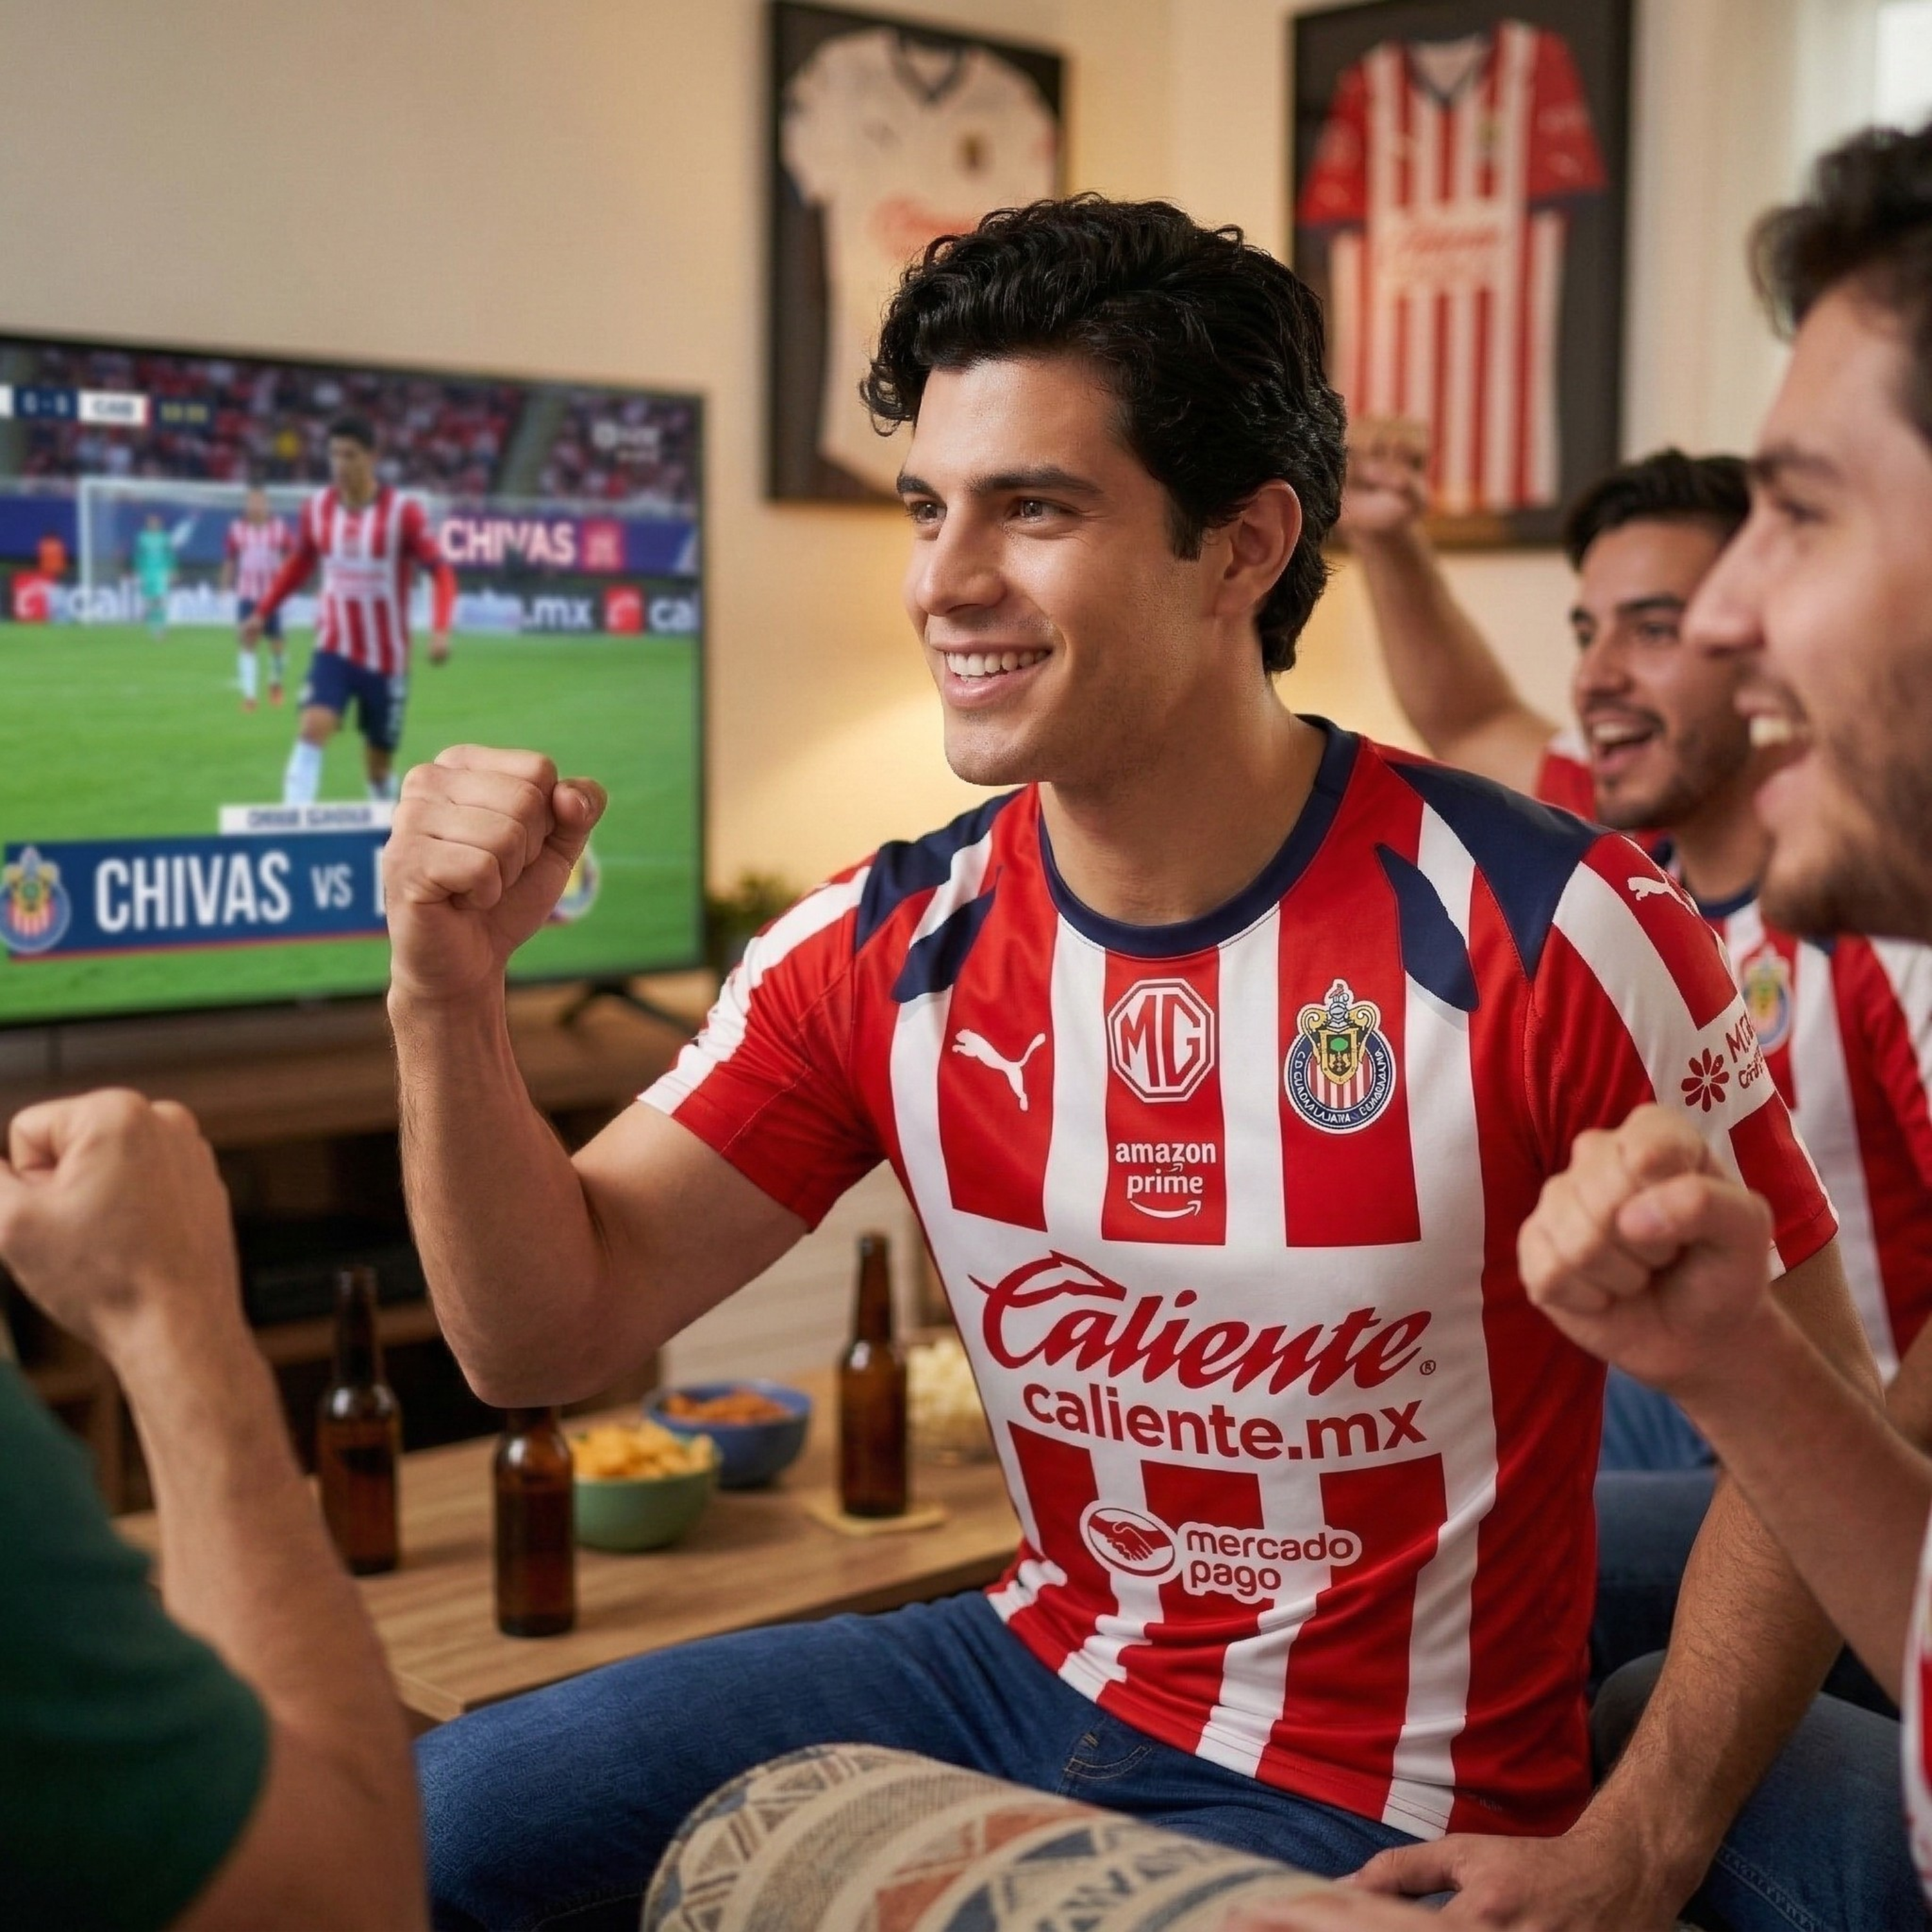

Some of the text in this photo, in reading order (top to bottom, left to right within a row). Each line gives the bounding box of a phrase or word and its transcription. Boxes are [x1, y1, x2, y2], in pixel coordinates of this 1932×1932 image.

[439, 518, 579, 567] CHIVAS
[95, 850, 291, 934] CHIVAS
[1121, 993, 1202, 1088] MG
[1115, 1140, 1216, 1164] amazon
[1126, 1168, 1203, 1199] prime
[967, 1249, 1432, 1397] Caliente
[1023, 1383, 1428, 1461] caliente.mx
[1186, 1528, 1354, 1562] mercado
[1189, 1559, 1282, 1596] pago
